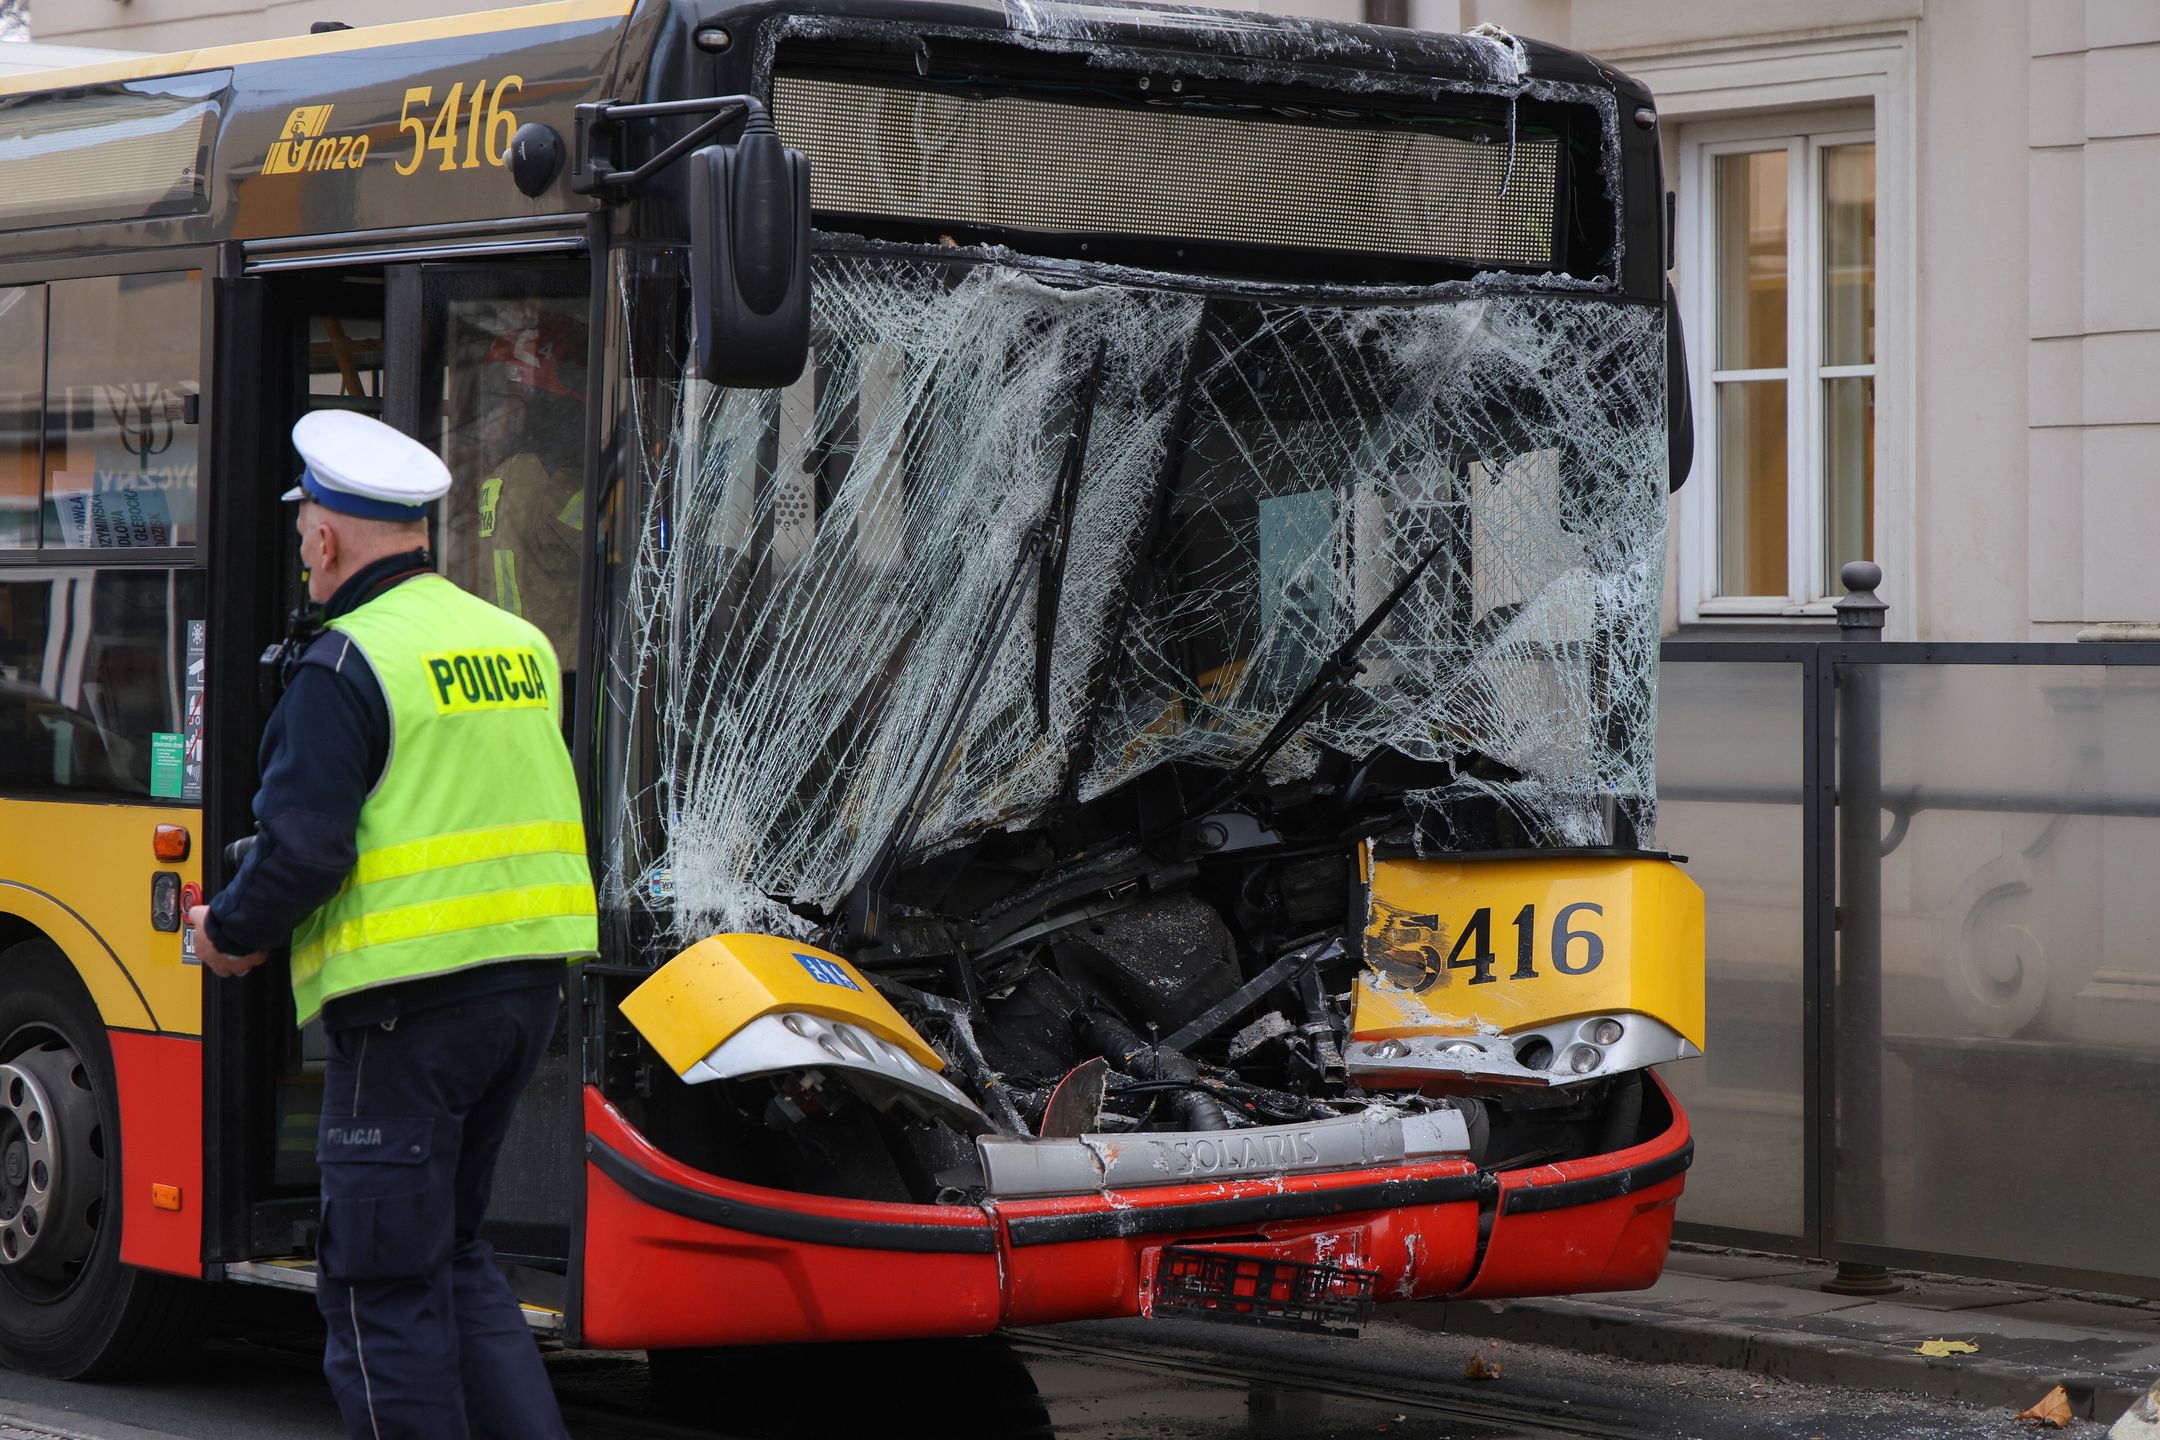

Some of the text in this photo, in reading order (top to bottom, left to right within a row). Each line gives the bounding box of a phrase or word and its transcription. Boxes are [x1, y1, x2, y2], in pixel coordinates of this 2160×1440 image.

[395, 75, 523, 176] 5416
[308, 134, 369, 171] mza
[429, 654, 548, 705] POLICJA
[327, 1128, 382, 1145] POLICJA
[1173, 1131, 1320, 1176] SOLARIS
